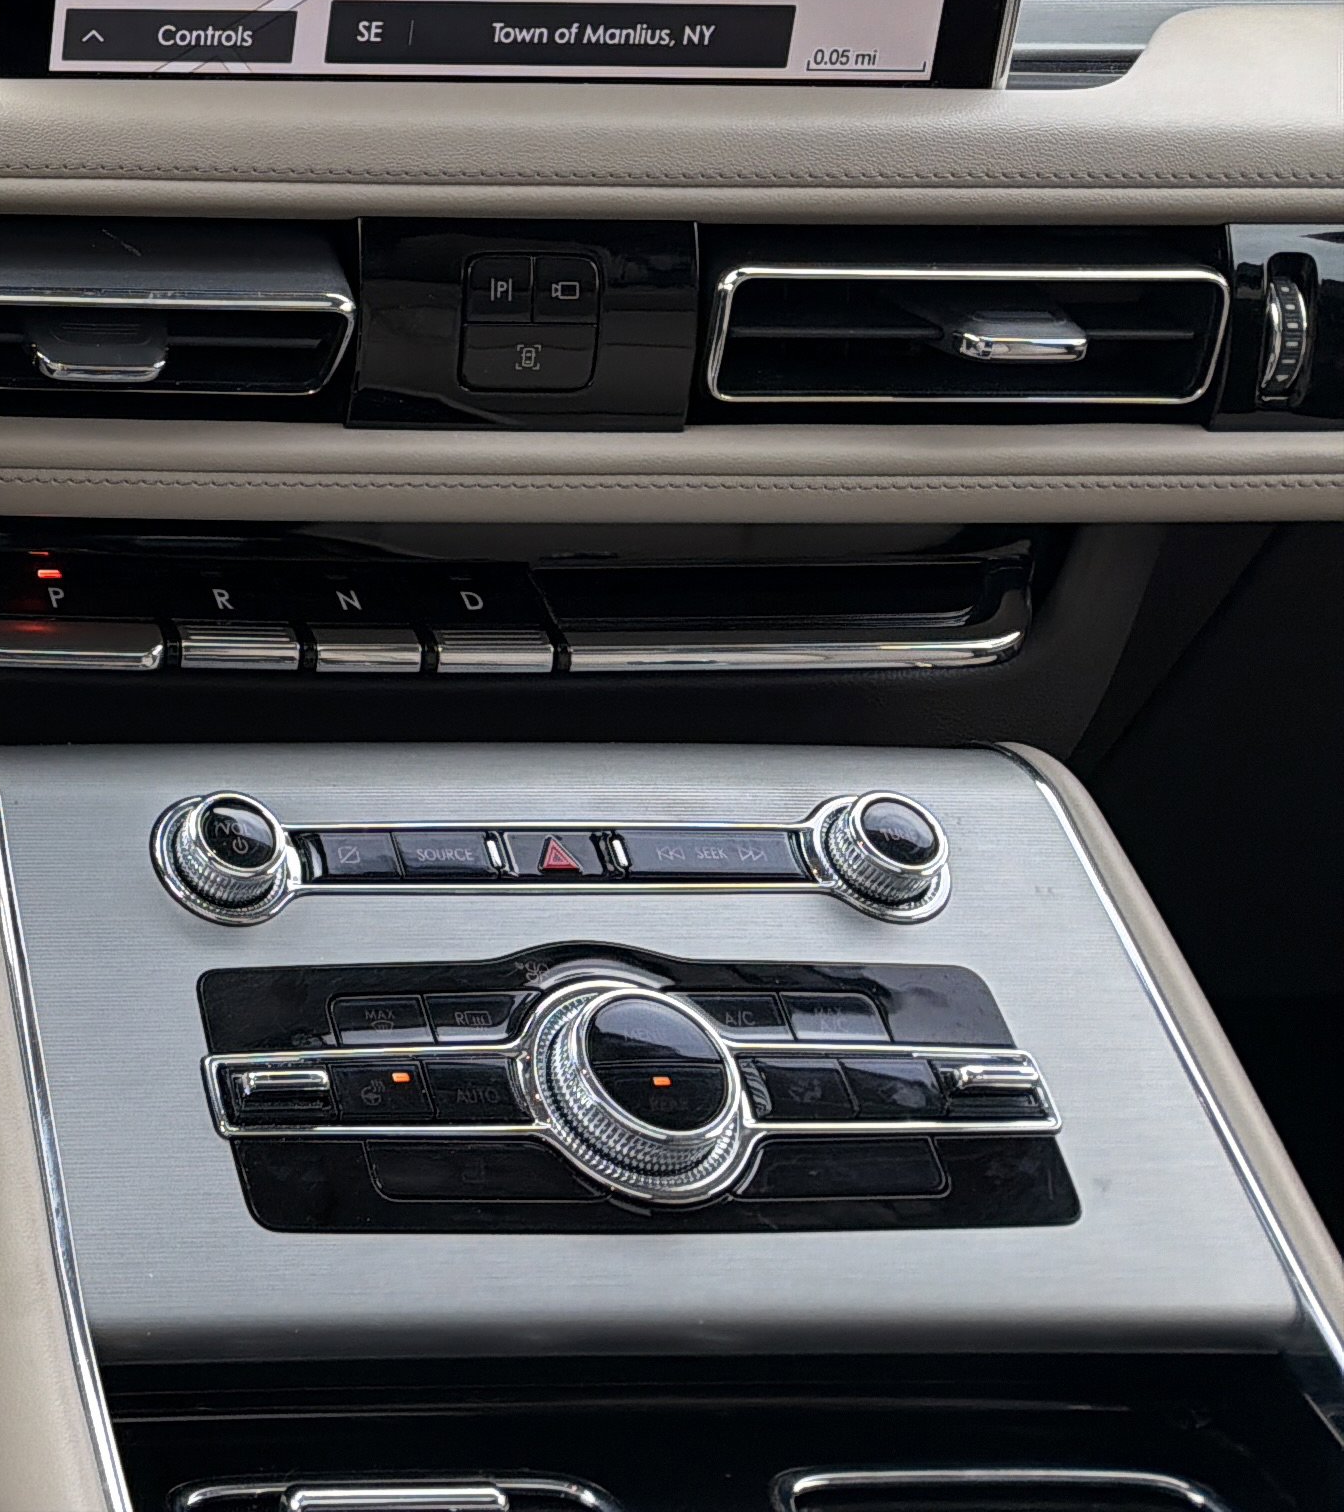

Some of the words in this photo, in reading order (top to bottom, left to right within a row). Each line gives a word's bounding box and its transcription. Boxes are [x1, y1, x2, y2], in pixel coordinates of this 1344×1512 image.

[158, 25, 253, 48] Controls
[357, 21, 383, 42] SE
[492, 23, 548, 43] Town
[554, 23, 579, 44] of
[582, 23, 675, 47] Manlius,
[682, 25, 716, 46] NY
[813, 49, 851, 67] 0.05
[855, 49, 878, 66] mi
[48, 588, 64, 608] P
[213, 589, 234, 610] R
[336, 591, 362, 611] N
[460, 591, 483, 611] D
[416, 848, 475, 862] SOURCE
[696, 847, 728, 860] SEEK
[365, 1009, 396, 1020] MAX
[725, 1011, 756, 1026] A/C
[456, 1088, 499, 1104] AUTO
